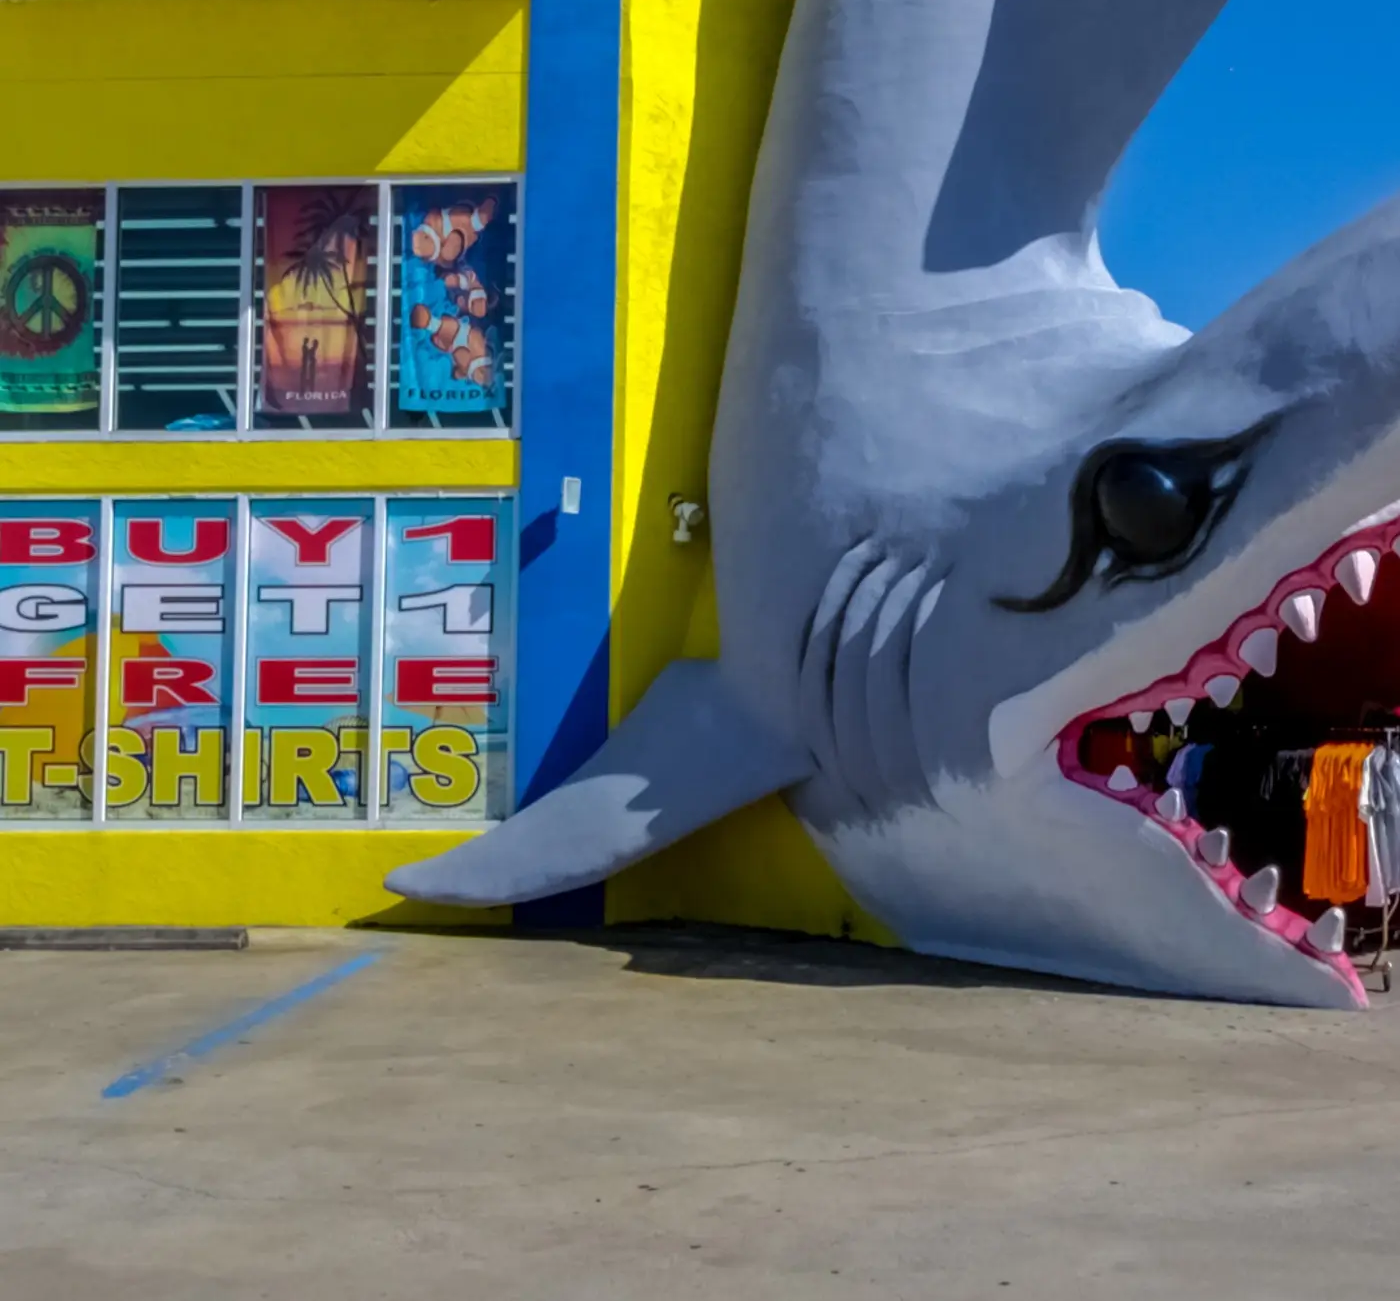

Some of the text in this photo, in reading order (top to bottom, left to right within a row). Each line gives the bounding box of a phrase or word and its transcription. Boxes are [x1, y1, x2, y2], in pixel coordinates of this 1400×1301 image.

[285, 390, 347, 401] FLORIDA
[408, 385, 496, 401] FLORIDA
[0, 514, 497, 565] BUY 1
[0, 583, 494, 634] GET 1
[0, 657, 499, 706] FREE
[0, 725, 481, 807] T-SHIRTS
